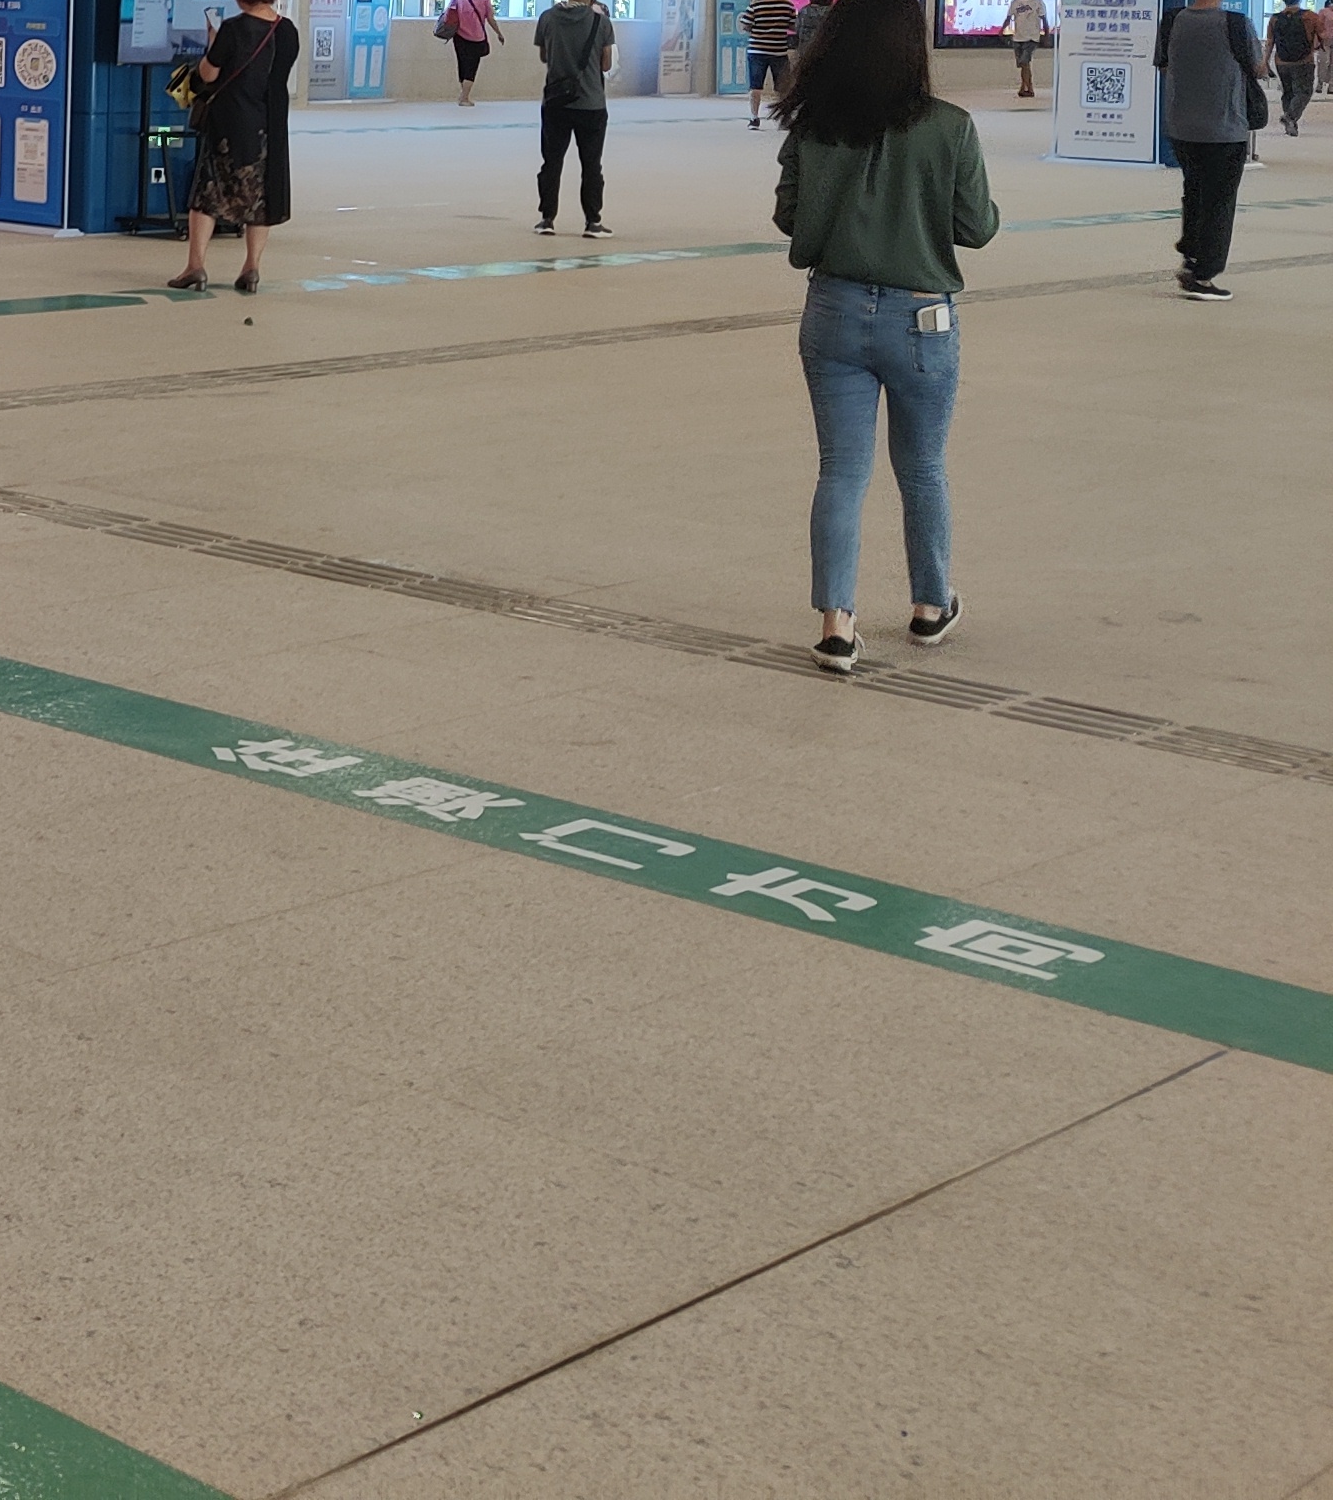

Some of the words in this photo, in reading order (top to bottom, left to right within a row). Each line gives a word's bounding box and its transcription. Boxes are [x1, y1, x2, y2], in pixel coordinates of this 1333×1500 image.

[1064, 9, 1153, 20] 发热咳嗽尽快就医
[212, 737, 1105, 980] 往澳门方向
